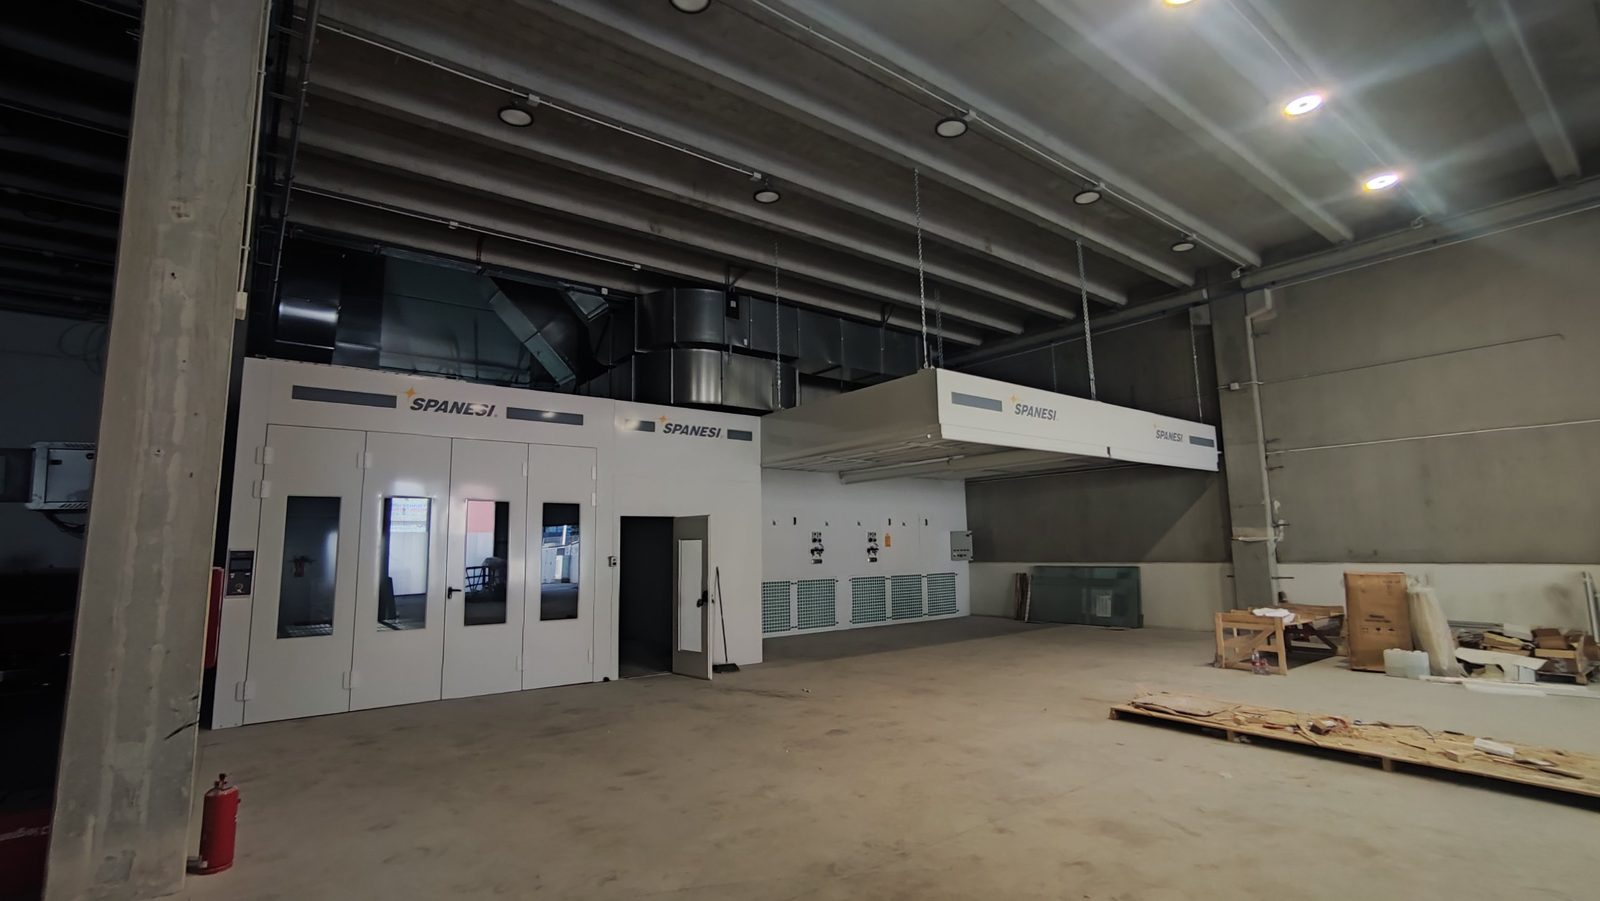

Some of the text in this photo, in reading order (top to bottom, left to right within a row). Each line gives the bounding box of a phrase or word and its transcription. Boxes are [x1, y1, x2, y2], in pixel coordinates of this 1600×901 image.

[410, 397, 496, 417] SPANESI
[1015, 404, 1057, 421] SPANESI
[663, 423, 721, 438] SPANESI
[1156, 430, 1183, 442] SPANESI
